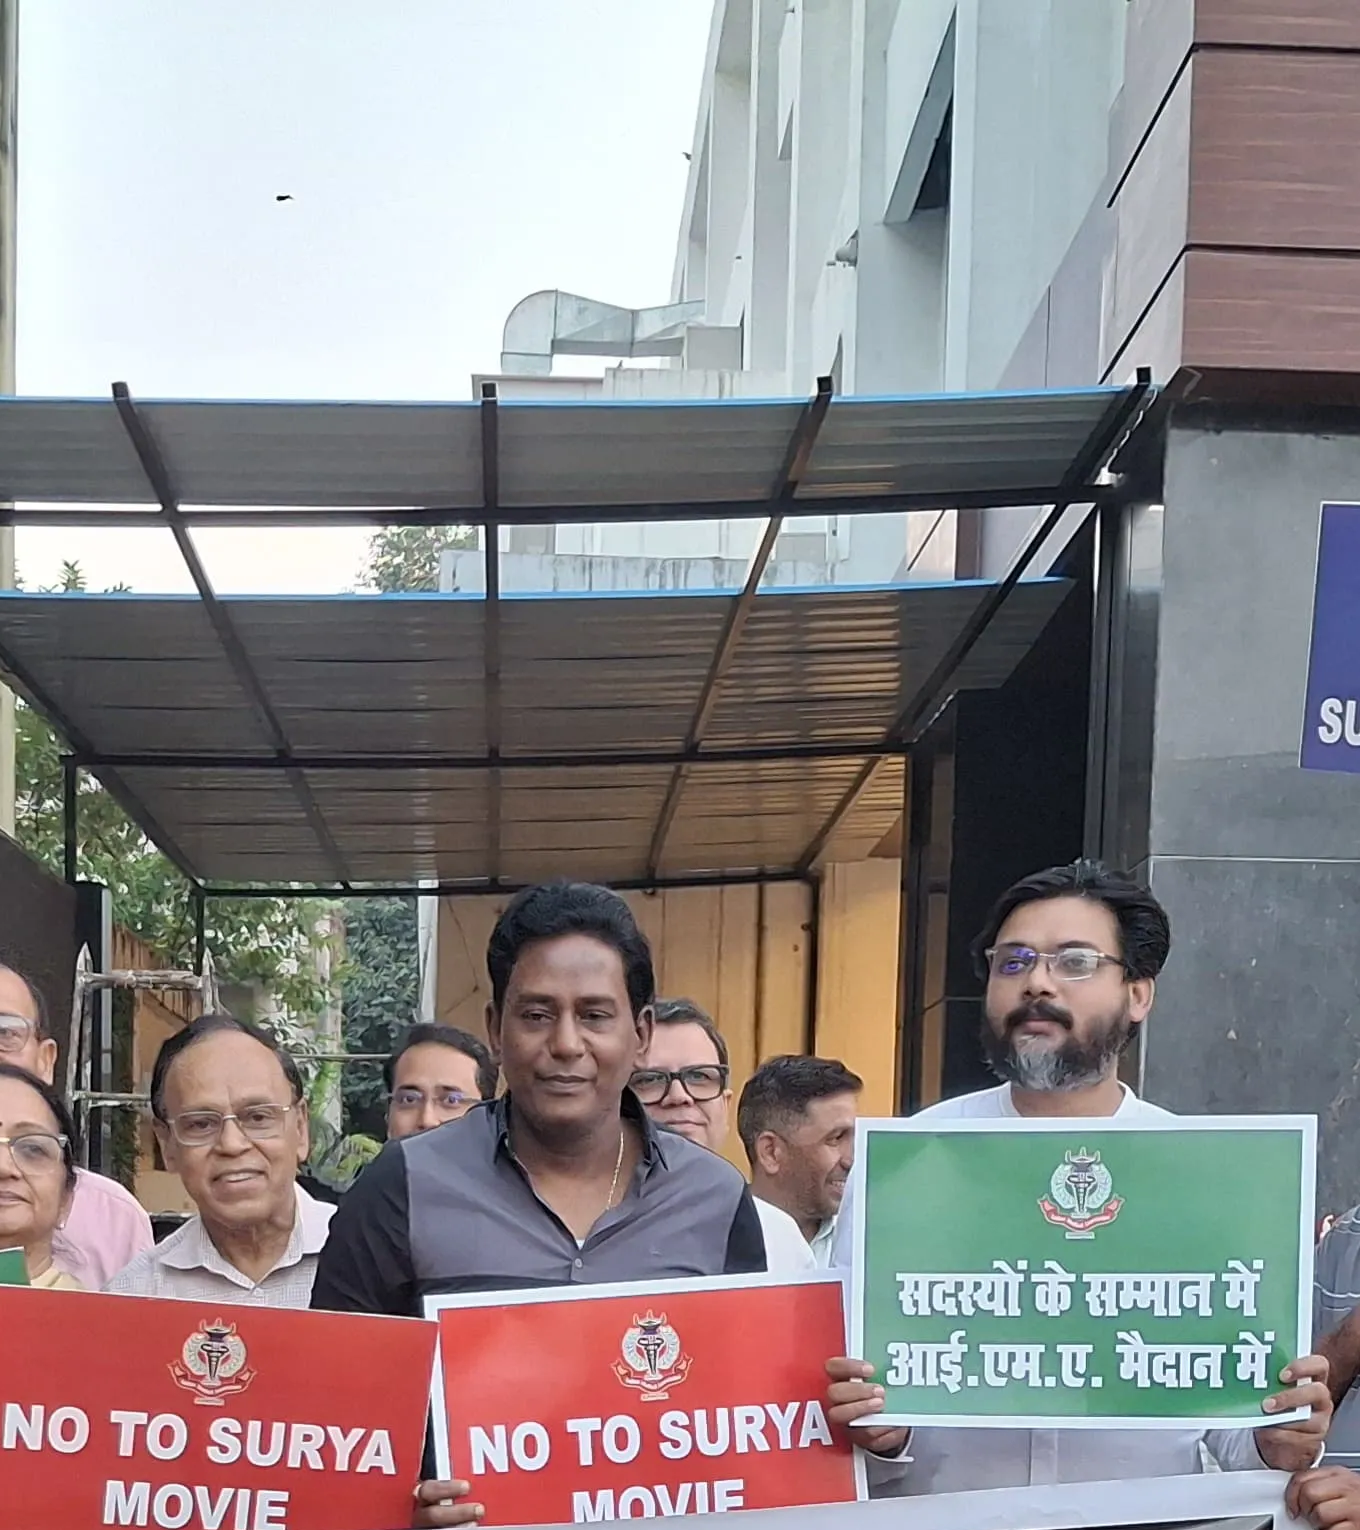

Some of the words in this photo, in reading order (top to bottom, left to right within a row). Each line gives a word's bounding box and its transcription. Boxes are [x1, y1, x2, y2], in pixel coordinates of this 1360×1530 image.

[895, 1260, 1028, 1317] सदस्यों
[1031, 1260, 1077, 1316] के
[1082, 1273, 1216, 1316] सम्मान
[1221, 1258, 1264, 1316] में
[886, 1330, 1102, 1393] आई.एम.ए.
[1115, 1331, 1226, 1388] मैदान
[1232, 1331, 1275, 1388] में
[2, 1404, 90, 1455] NO
[109, 1411, 188, 1461] TO
[206, 1420, 398, 1477] SURYA
[469, 1422, 551, 1476] NO
[566, 1415, 641, 1467] TO
[658, 1399, 833, 1460] SURYA
